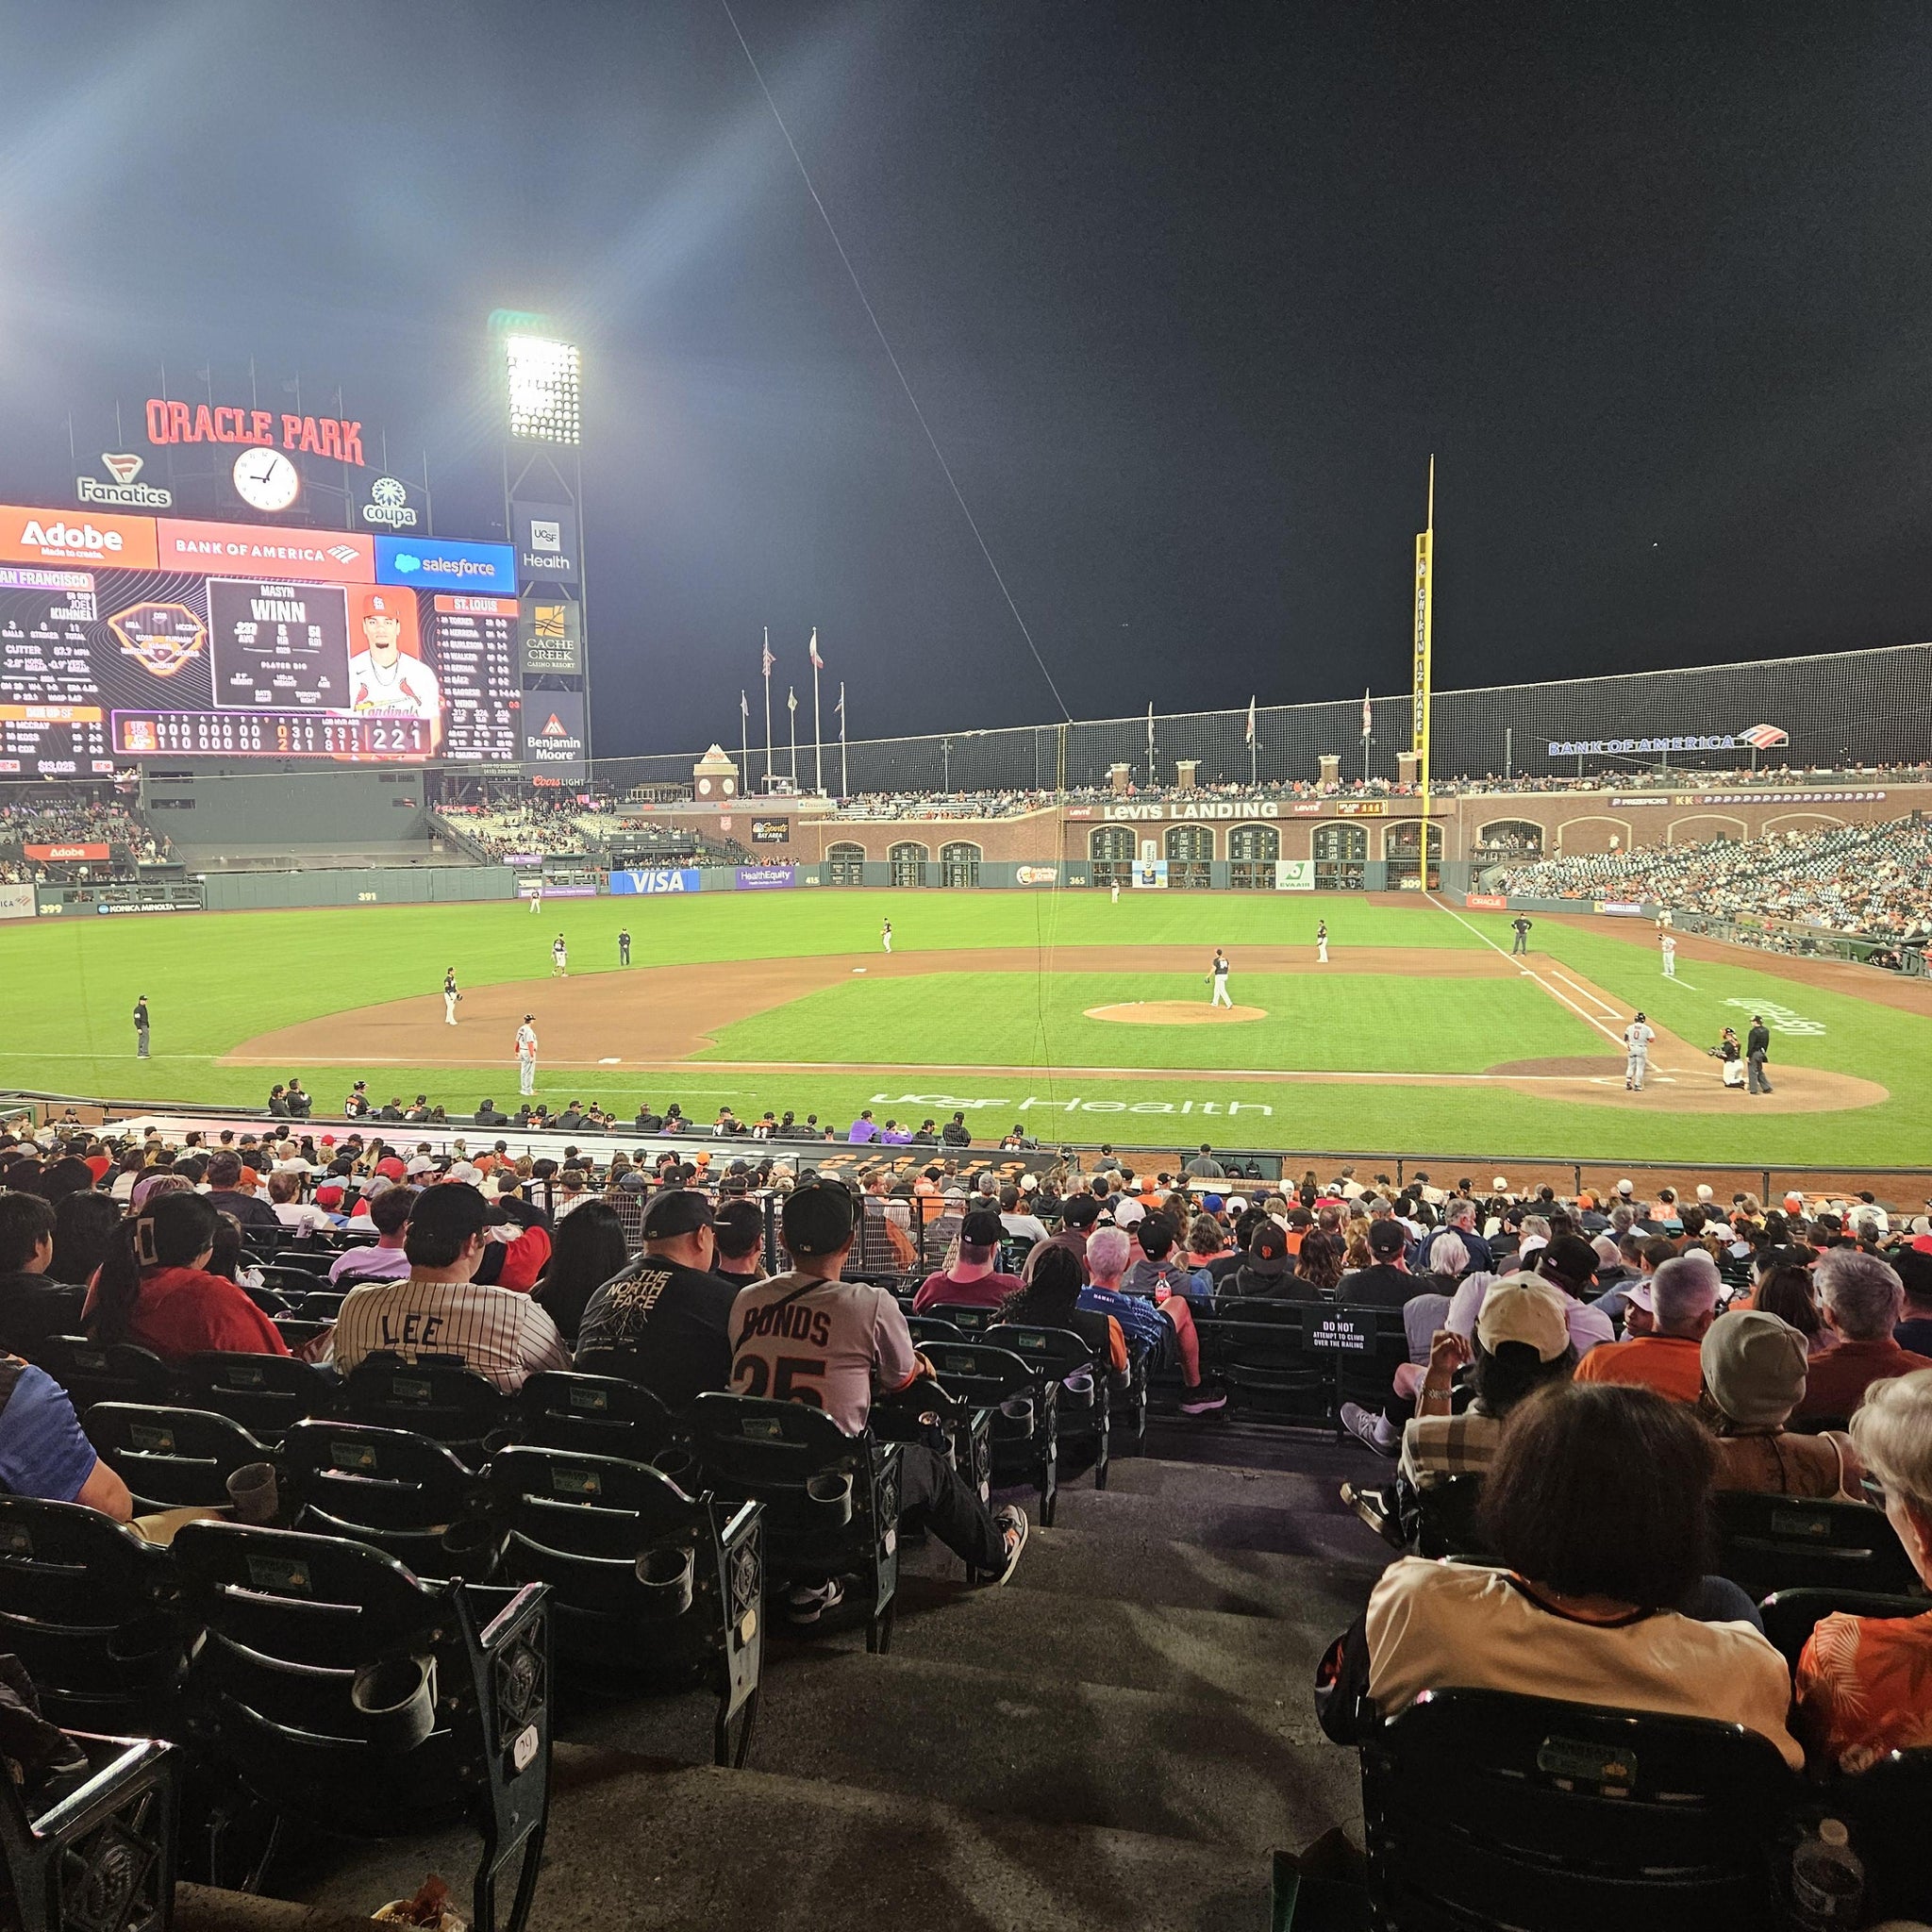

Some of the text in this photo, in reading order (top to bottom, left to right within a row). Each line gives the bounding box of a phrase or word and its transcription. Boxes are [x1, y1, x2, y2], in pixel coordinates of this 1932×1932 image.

[146, 399, 366, 467] ORACLE PARK
[79, 478, 170, 507] Fanatics
[364, 503, 417, 526] coupa
[20, 521, 123, 550] Adobe
[535, 528, 558, 542] UCSF
[176, 539, 325, 561] BANK OF AMERICA
[422, 557, 495, 576] salesforce
[523, 553, 570, 570] Health
[19, 571, 89, 588] FRANCISCO
[260, 585, 295, 597] MASYN
[250, 599, 306, 623] WINN
[470, 599, 498, 612] LOUIS
[1417, 589, 1426, 653] CHIKIN
[5, 644, 42, 655] CUTTER
[526, 639, 575, 650] CACHE
[527, 650, 574, 660] CREEK
[157, 723, 358, 740] 0 0 0 0 0 0 0 0 0 3 0 9 3 1
[158, 736, 359, 752] 1 1 0 0 0 0 0 0 2 6 1 8 1 2
[373, 728, 421, 750] 2 2 1
[526, 737, 581, 751] Benjamin
[1549, 734, 1735, 756] BANK OF AMERICA
[532, 774, 585, 788] Coors LIGHT
[1622, 797, 1668, 806] PRIZEPICKS
[1675, 795, 1694, 805] K K
[1171, 802, 1278, 819] LANDING
[763, 821, 789, 833] Sports
[50, 847, 85, 858] Adobe
[626, 871, 685, 892] VISA
[741, 870, 791, 881] HealthEquity
[805, 876, 819, 885] 415
[1069, 876, 1086, 885] 365
[1400, 879, 1421, 889] 309
[358, 891, 376, 901] 391
[1472, 898, 1502, 907] ORACLE
[39, 904, 63, 914] 399
[109, 905, 141, 913] KONICA
[141, 903, 175, 912] MINOLTA
[869, 1093, 1274, 1116] UCSF Health
[817, 1154, 1026, 1179] GIANTS
[639, 1269, 673, 1283] THE
[605, 1280, 667, 1297] NORTH
[612, 1293, 658, 1309] FACE
[1093, 1293, 1115, 1304] HAWAII
[382, 1314, 444, 1346] LEE
[743, 1303, 831, 1348] BONDS
[1323, 1321, 1355, 1333] DO NOT
[1313, 1331, 1337, 1340] ATTEMPT
[1341, 1341, 1364, 1349] RAILING
[732, 1354, 828, 1410] 25
